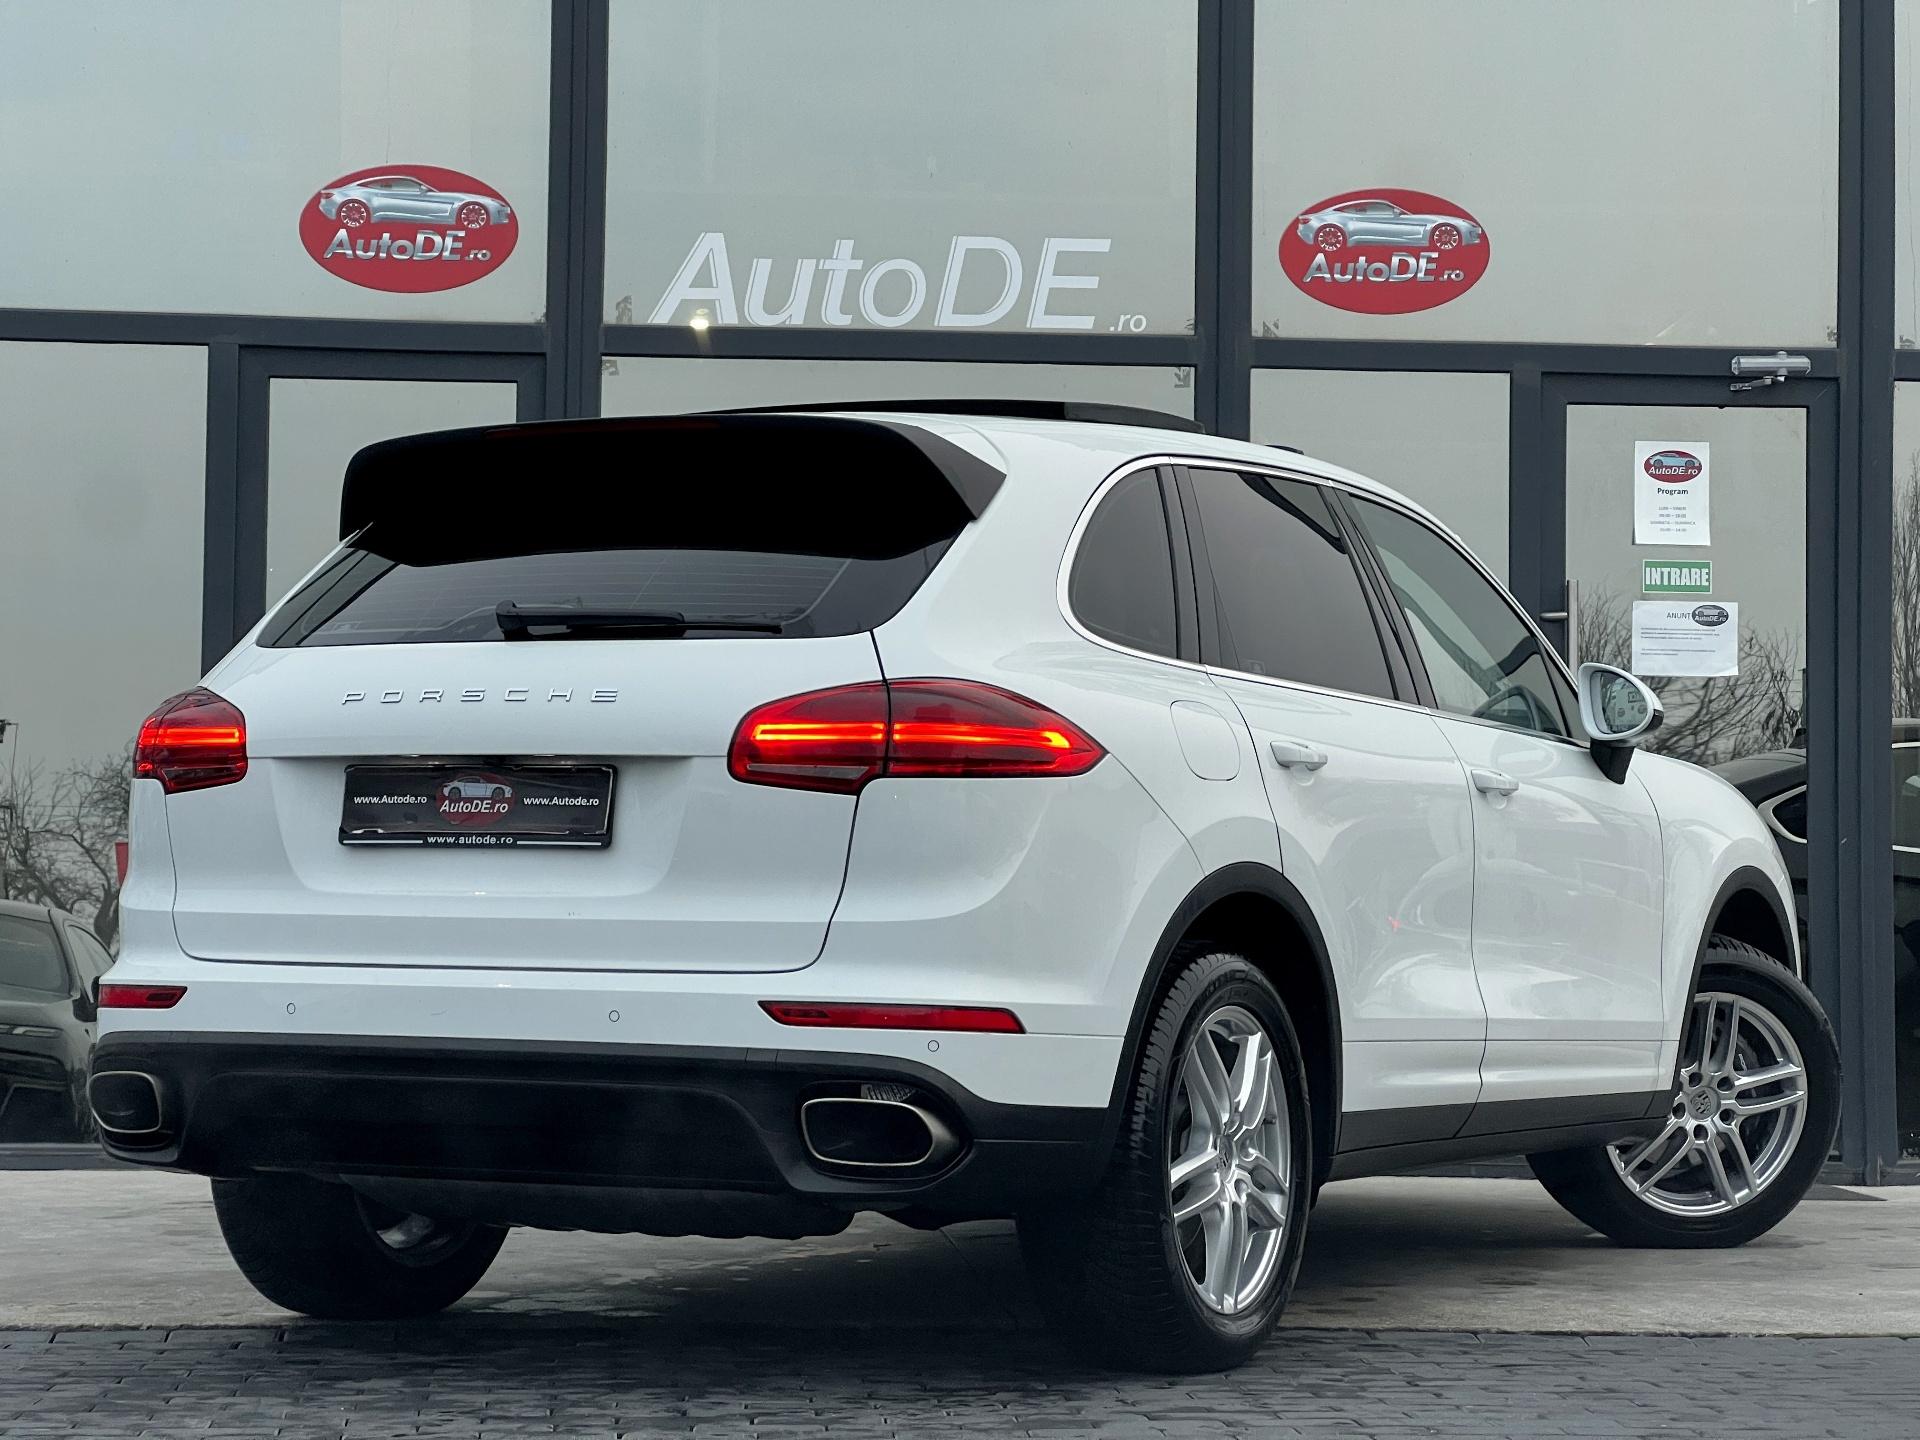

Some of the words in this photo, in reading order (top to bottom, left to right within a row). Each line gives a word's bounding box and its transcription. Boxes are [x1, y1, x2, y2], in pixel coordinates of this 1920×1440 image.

[1648, 466, 1699, 476] AutoDE.ro
[1657, 487, 1689, 496] Program
[1645, 567, 1709, 586] INTRARE
[1666, 612, 1691, 620] ANUNT
[342, 687, 619, 705] PORSCHE
[353, 794, 427, 804] www.Autode.ro
[523, 796, 599, 806] www.Autode.ro
[439, 799, 509, 814] AutoDE.ro
[427, 834, 513, 845] www.autode.ro
